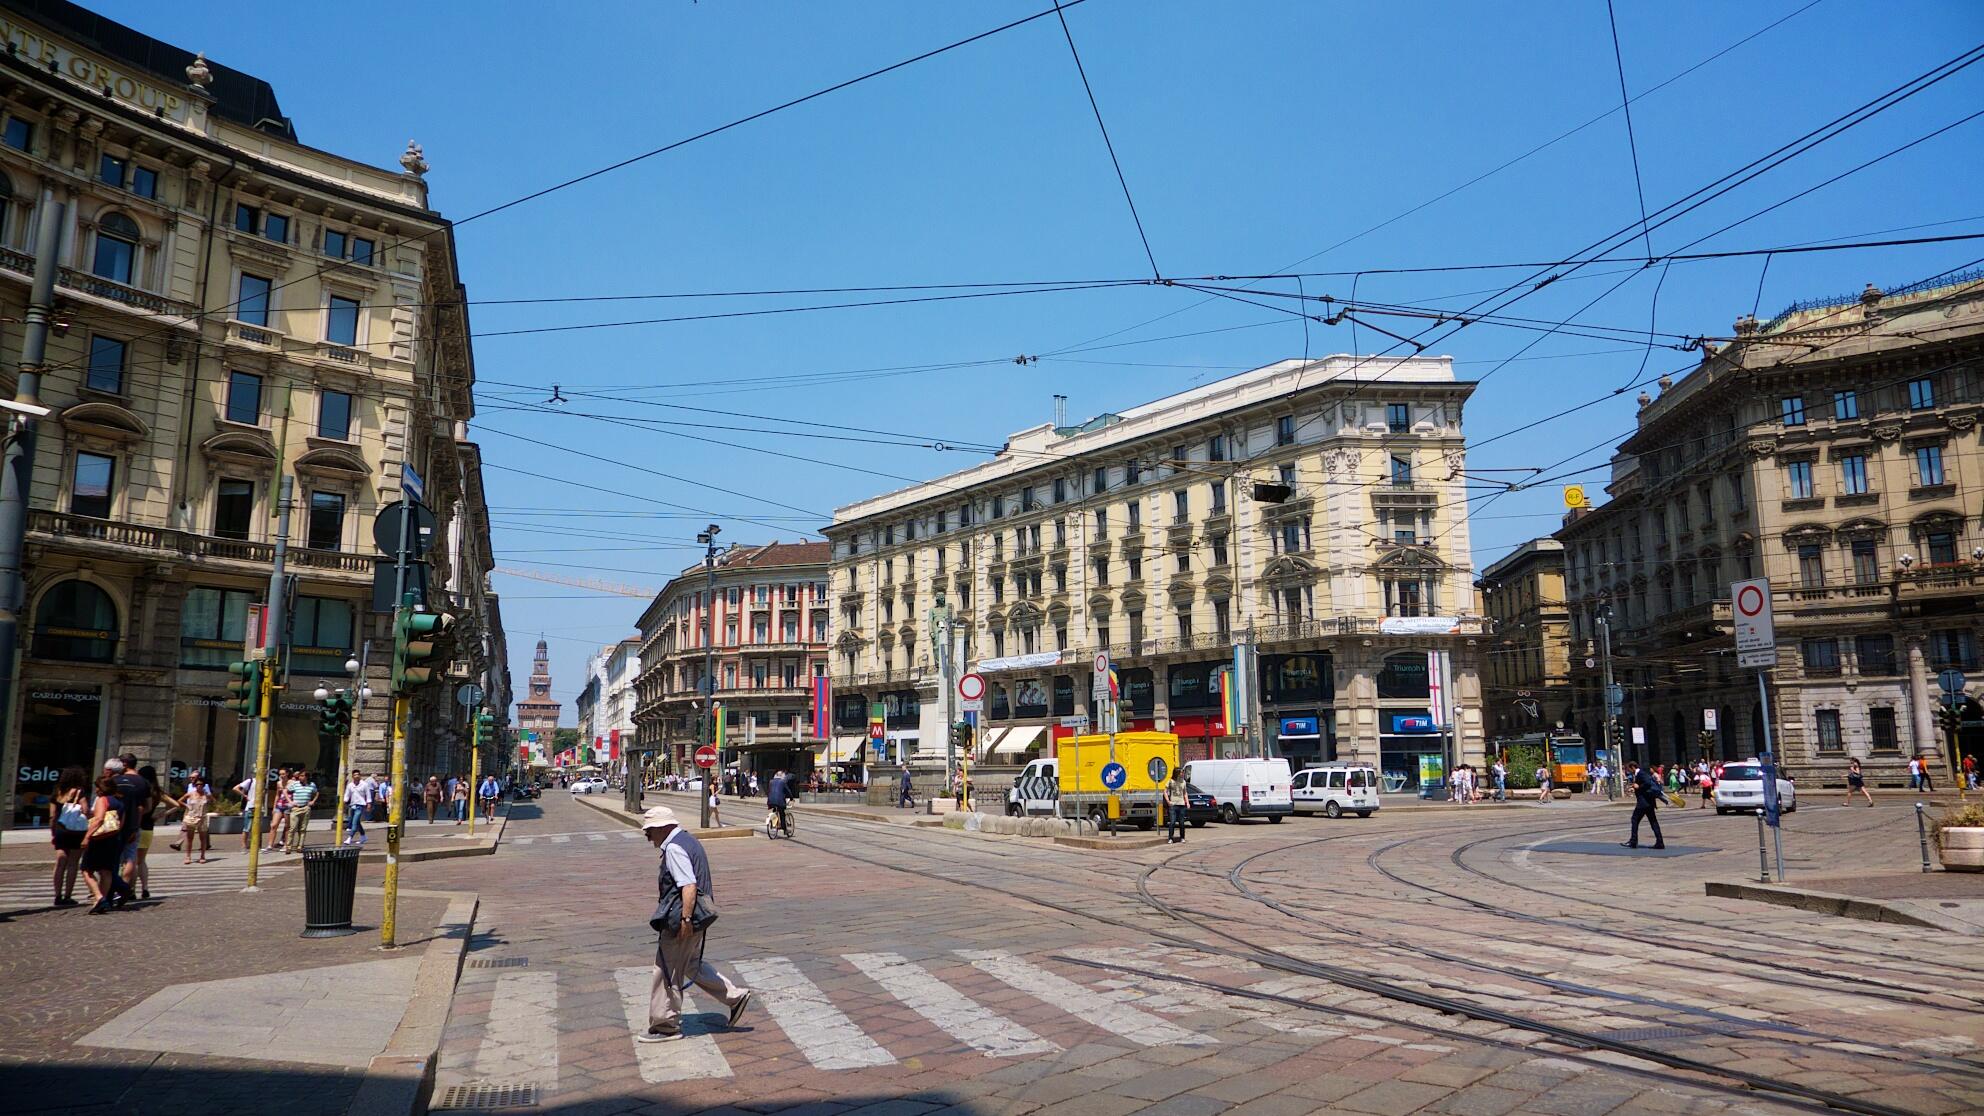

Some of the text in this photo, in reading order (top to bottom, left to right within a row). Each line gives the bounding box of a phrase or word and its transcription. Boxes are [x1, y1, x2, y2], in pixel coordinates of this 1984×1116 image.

[68, 56, 180, 119] GROUP
[1392, 664, 1421, 673] Triumph
[32, 691, 62, 700] CARLO
[1295, 722, 1307, 730] TIM
[1415, 719, 1428, 727] TIM
[872, 725, 883, 736] M
[19, 766, 60, 781] Sale
[170, 766, 206, 779] Sali
